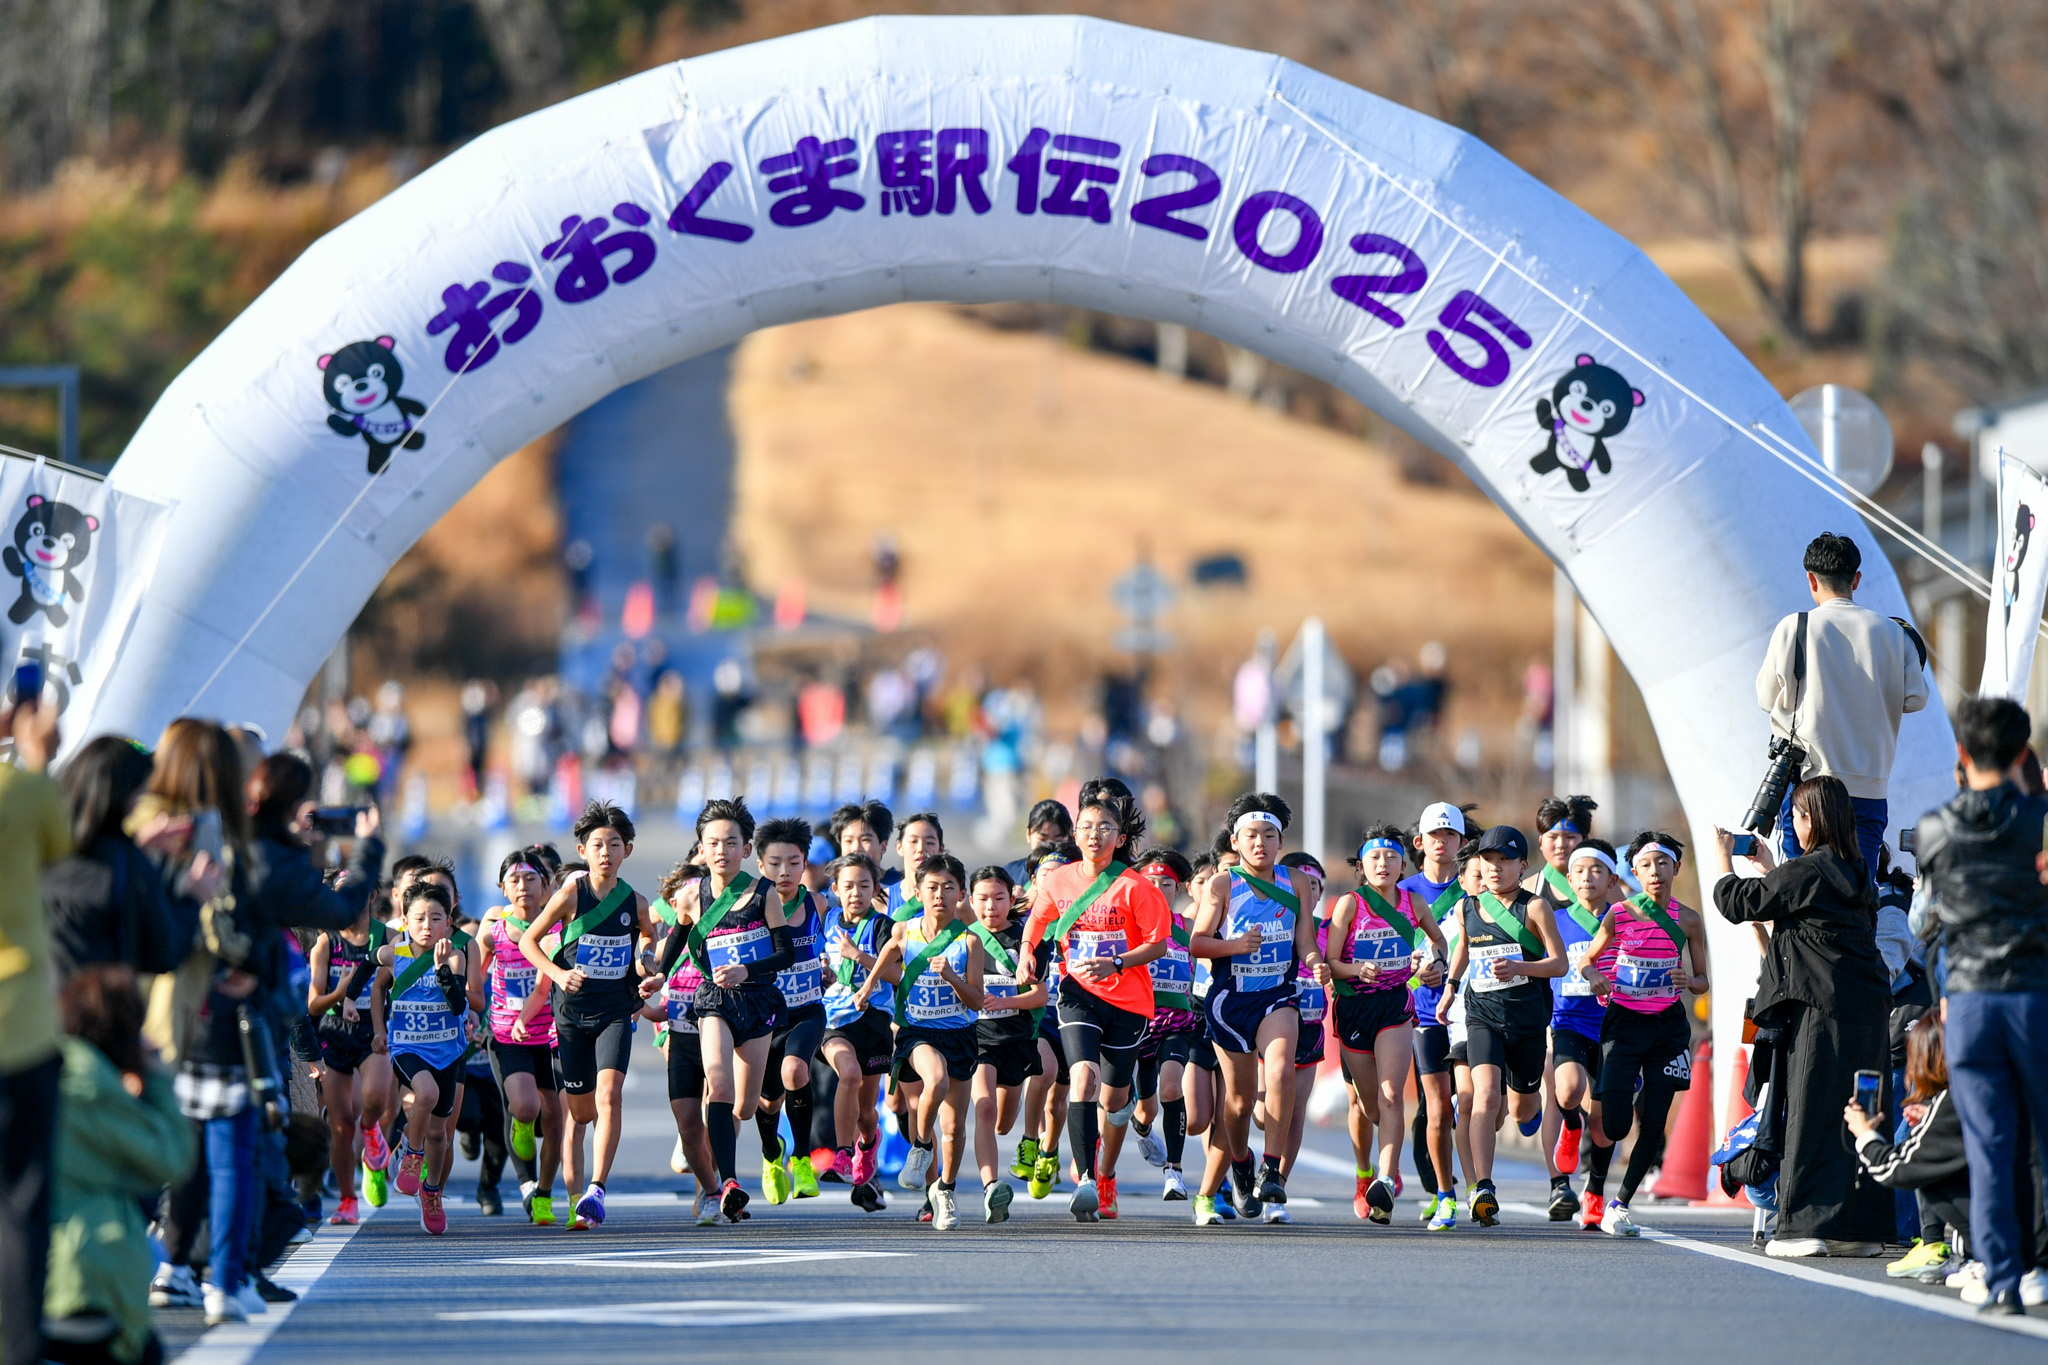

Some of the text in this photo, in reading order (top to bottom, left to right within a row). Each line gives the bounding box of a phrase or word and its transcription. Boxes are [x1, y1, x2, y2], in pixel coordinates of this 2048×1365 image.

[426, 127, 1532, 388] おおくま駅伝2025
[751, 929, 768, 940] 2025
[1247, 920, 1283, 933] TOWA
[587, 947, 626, 967] 25-1
[727, 946, 757, 965] 3-1
[1078, 942, 1117, 959] 27-1
[1372, 940, 1398, 959] 7-1
[1501, 946, 1518, 954] 2025
[805, 960, 819, 970] 2025
[1661, 959, 1676, 967] 2025
[604, 969, 615, 977] Lab
[615, 969, 619, 977] A
[1629, 967, 1666, 988] 17-1
[775, 974, 813, 995] 24-1
[919, 987, 957, 1007] 31-1
[395, 1004, 434, 1012] おおくま駅伝
[404, 1012, 446, 1031] 33-1
[1663, 1066, 1691, 1080] adid
